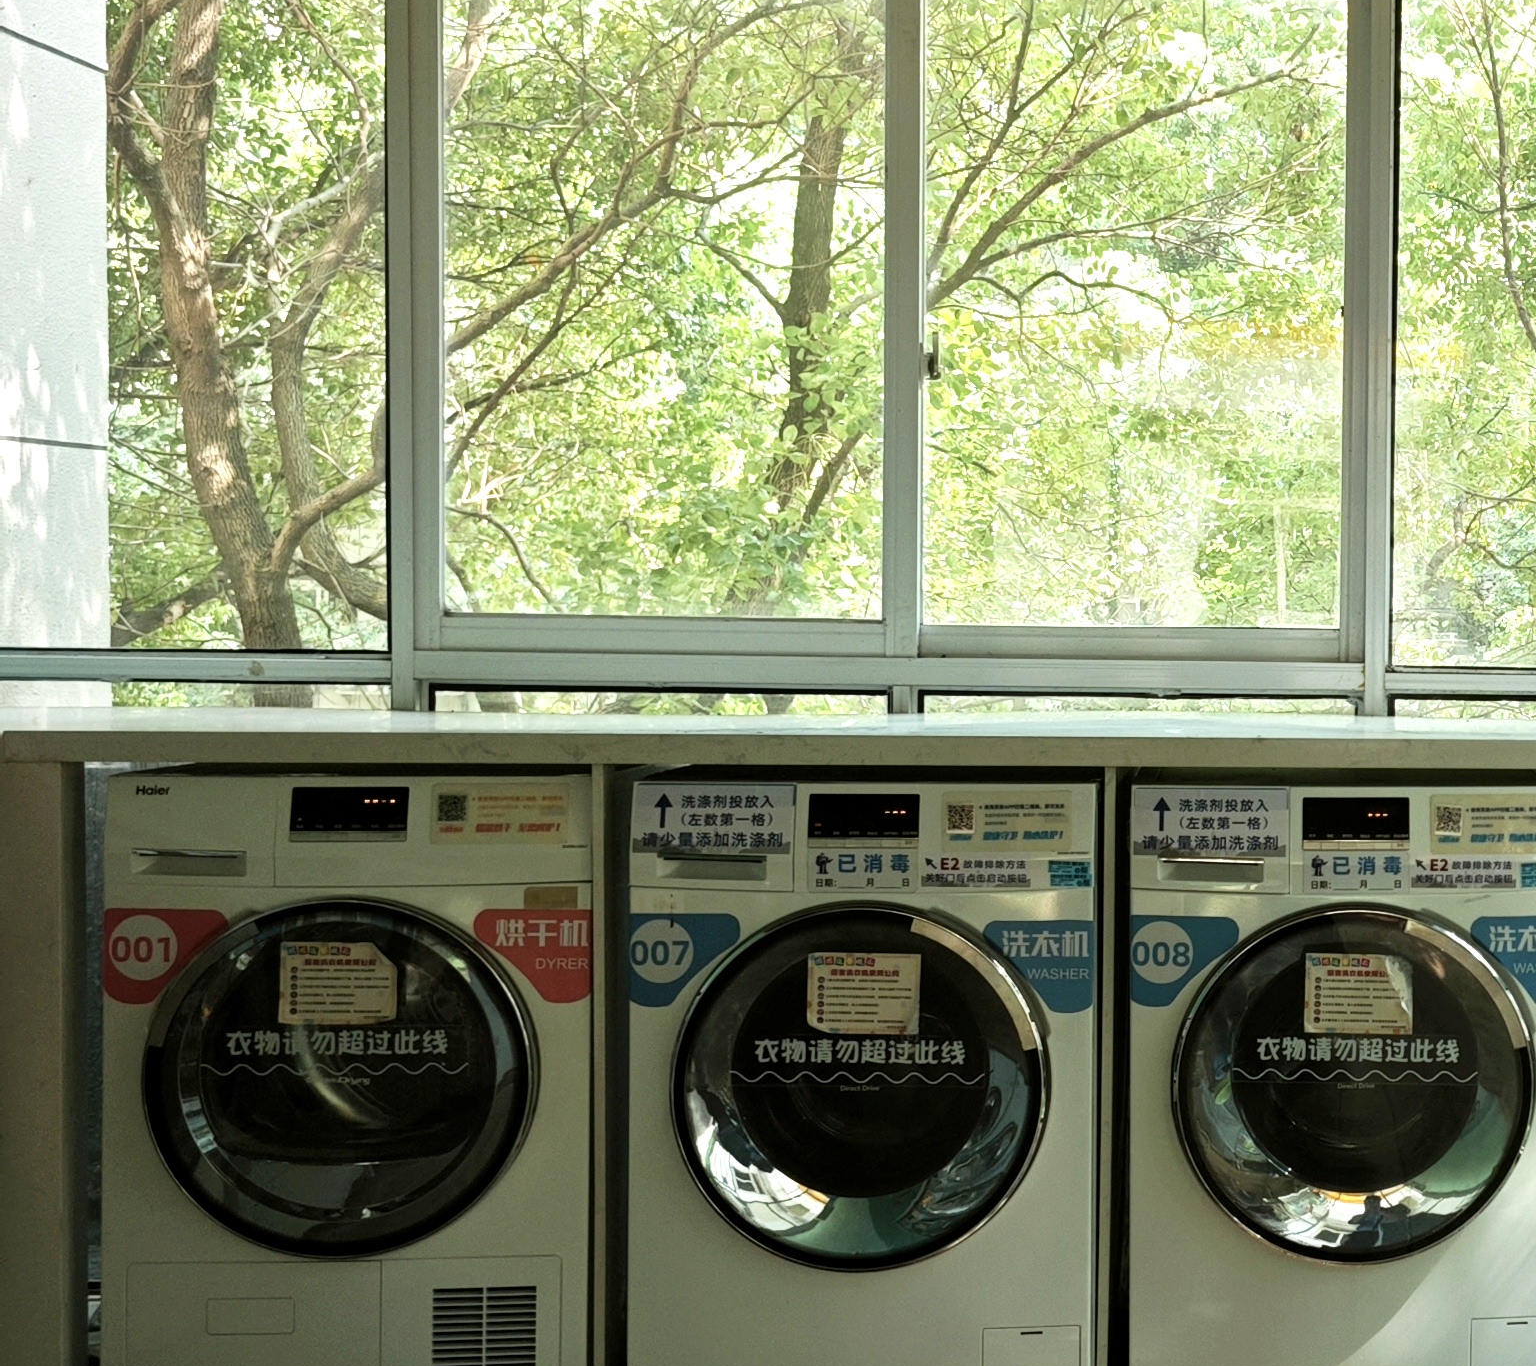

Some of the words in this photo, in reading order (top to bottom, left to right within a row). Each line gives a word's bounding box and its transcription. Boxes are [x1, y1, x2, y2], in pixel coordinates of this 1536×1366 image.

[136, 785, 170, 796] Haier
[681, 794, 775, 809] 洗涤剂投放入
[1178, 798, 1269, 813] 洗涤剂投放入
[681, 812, 774, 827] (左数第一格)
[1179, 816, 1269, 831] (左数第一格)
[642, 831, 783, 848] 请少量添加洗涤剂
[1142, 835, 1280, 851] 请少量添加洗涤剂
[838, 853, 910, 874] 已消毒
[940, 857, 960, 871] E2
[963, 859, 1026, 870] 故障排除方法
[1332, 856, 1402, 875] 已消毒
[1429, 858, 1449, 872] E2
[1452, 860, 1512, 871] 故障排除方法
[925, 872, 1028, 884] 关好门后点击启动按钮
[1414, 873, 1513, 885] 关好门后点击启动按钮
[495, 919, 589, 947] 烘干机
[111, 936, 171, 963] 001
[1001, 930, 1089, 958] 洗衣机
[630, 940, 690, 966] 007
[1131, 941, 1191, 967] 008
[535, 957, 589, 970] DYRER
[1026, 968, 1089, 981] WASHER
[225, 1029, 449, 1057] 衣物请勿超过此线
[1256, 1037, 1459, 1065] 衣物请勿超过此线
[754, 1039, 966, 1067] 衣物请勿超过此线
